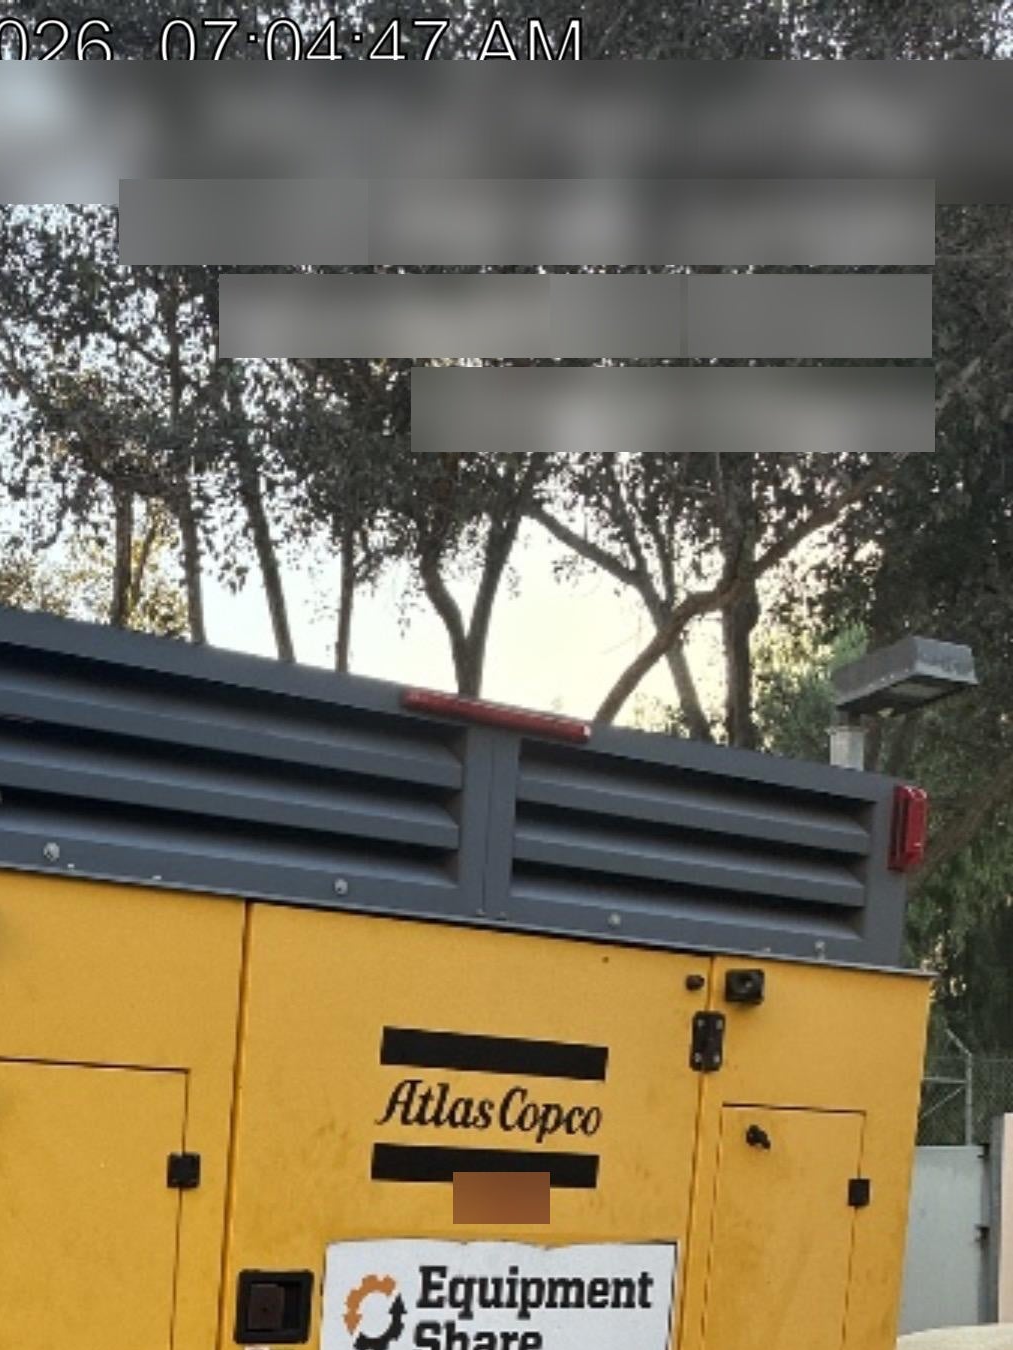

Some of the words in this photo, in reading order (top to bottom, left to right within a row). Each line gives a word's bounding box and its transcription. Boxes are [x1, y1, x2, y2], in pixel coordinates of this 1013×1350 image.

[375, 1078, 494, 1130] Atlas
[498, 1086, 603, 1144] Copco
[415, 1265, 654, 1320] Equipment
